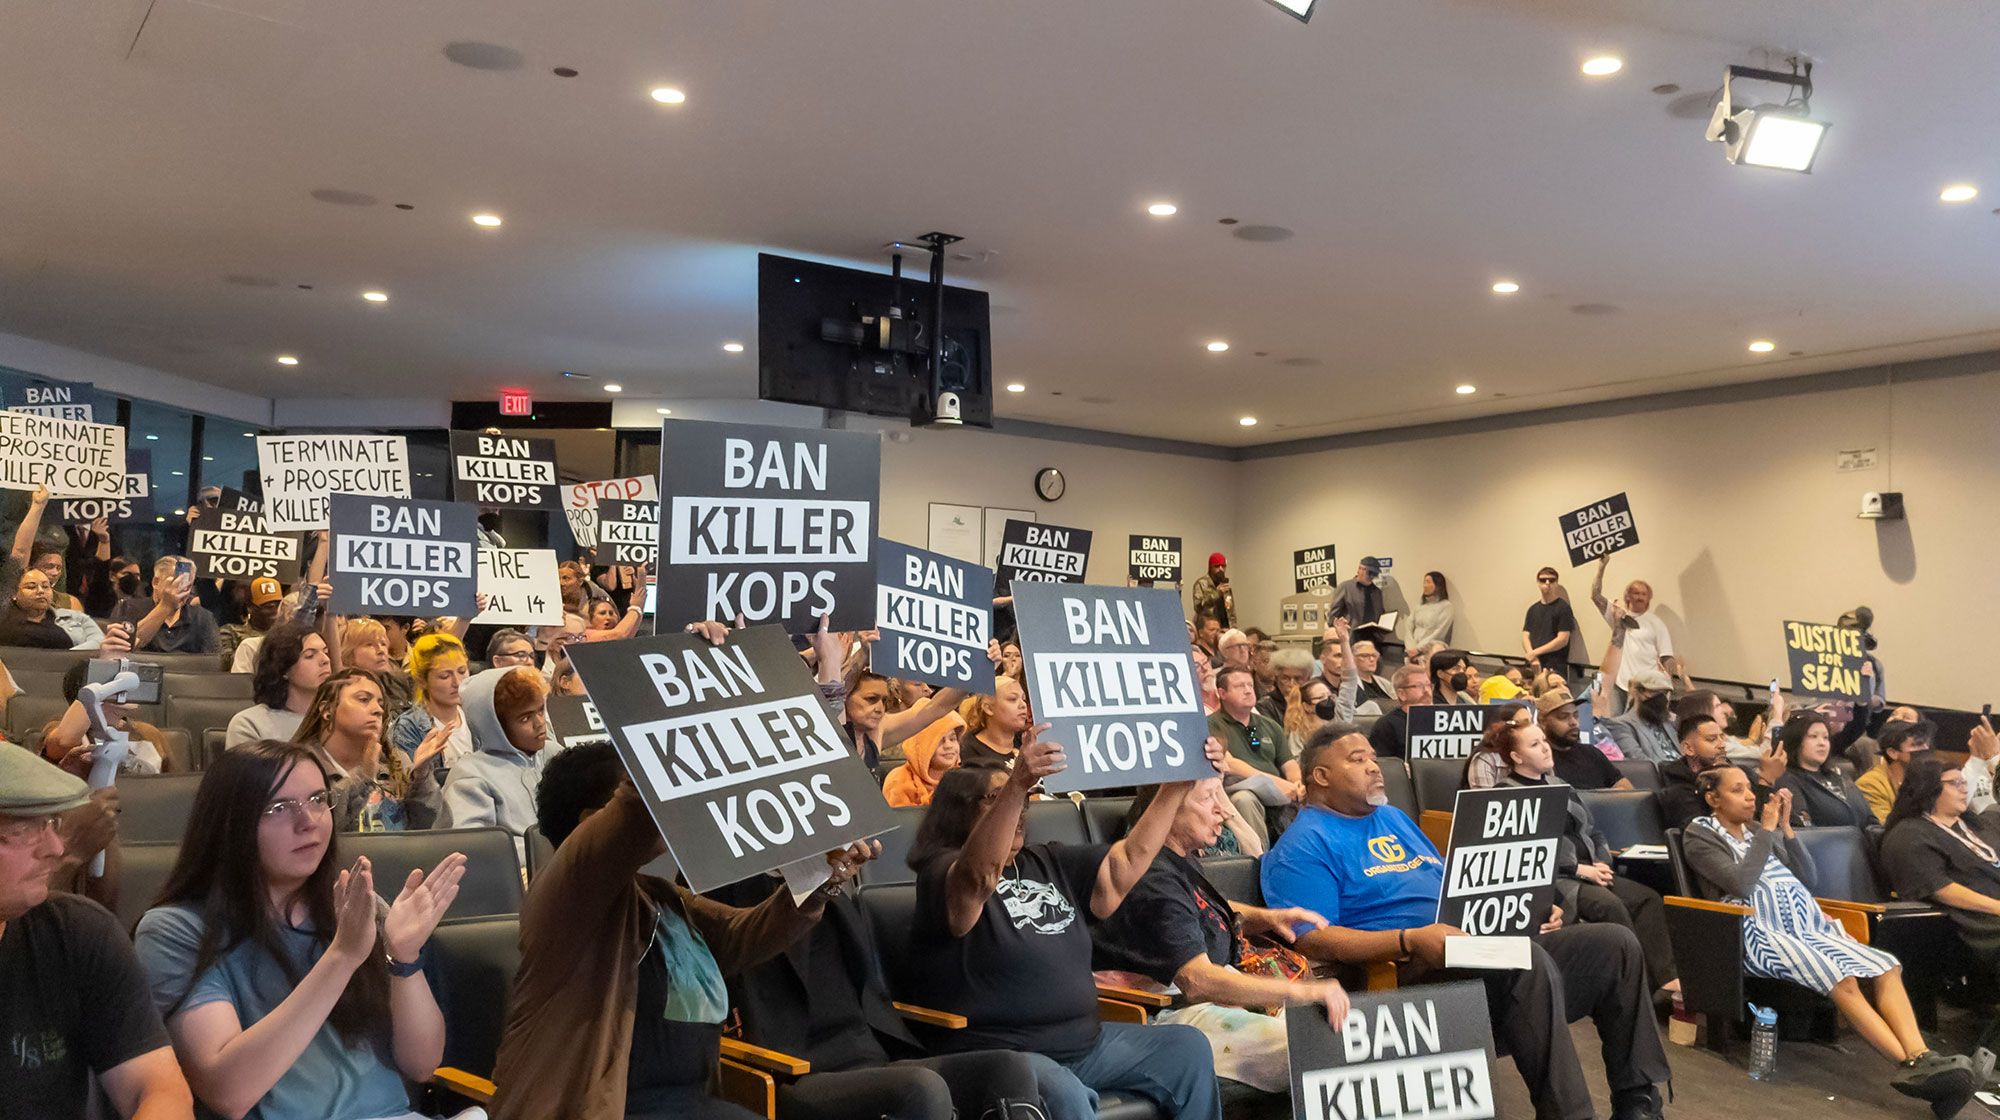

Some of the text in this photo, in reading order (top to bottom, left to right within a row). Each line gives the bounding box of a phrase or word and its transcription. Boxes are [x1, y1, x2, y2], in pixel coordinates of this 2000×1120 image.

[26, 387, 71, 403] BAN
[504, 396, 528, 413] EXIT
[266, 439, 399, 463] TERMINATE
[478, 437, 530, 458] BAN
[0, 456, 56, 487] ILLER
[64, 468, 125, 495] COPS!
[466, 459, 549, 482] KILLER
[724, 438, 827, 491] BAN
[284, 468, 404, 492] PROSECUTE
[477, 483, 542, 504] KOPS
[572, 478, 643, 507] STOP
[63, 499, 132, 520] KOPS
[220, 512, 275, 534] BAN
[371, 504, 441, 536] BAN
[1577, 502, 1612, 526] BAN
[202, 533, 289, 557] KILLER
[688, 506, 857, 555] KILLER
[1025, 526, 1070, 549] BAN
[1142, 538, 1169, 551] BAN
[1572, 516, 1627, 546] KILLER
[348, 540, 462, 573] KILLER
[1010, 547, 1078, 572] KILLER
[1135, 553, 1176, 565] KILLER
[1304, 549, 1325, 563] BAN
[1582, 532, 1626, 560] KOPS
[208, 555, 278, 577] KOPS
[904, 554, 964, 599] BAN
[1139, 566, 1172, 579] KOPS
[1299, 562, 1332, 577] KILLER
[361, 577, 450, 608] KOPS
[485, 594, 545, 613] AL 14
[706, 570, 837, 622] KOPS
[887, 592, 980, 643] KILLER
[1063, 598, 1150, 645] BAN
[1788, 622, 1863, 657] JUSTICE
[898, 637, 972, 681] KOPS
[1818, 653, 1843, 667] FOR
[639, 644, 765, 708] BAN
[1049, 661, 1188, 709] KILLER
[1801, 663, 1861, 696] SEAN
[1434, 710, 1483, 732] BAN
[645, 706, 834, 788] KILLER
[1077, 720, 1185, 774] KOPS
[706, 773, 851, 858] KOPS
[1483, 798, 1541, 838] BAN
[1458, 846, 1548, 889] KILLER
[1461, 892, 1533, 936] KOPS
[1342, 999, 1441, 1063] BAN
[1319, 1064, 1484, 1120] KILLER
